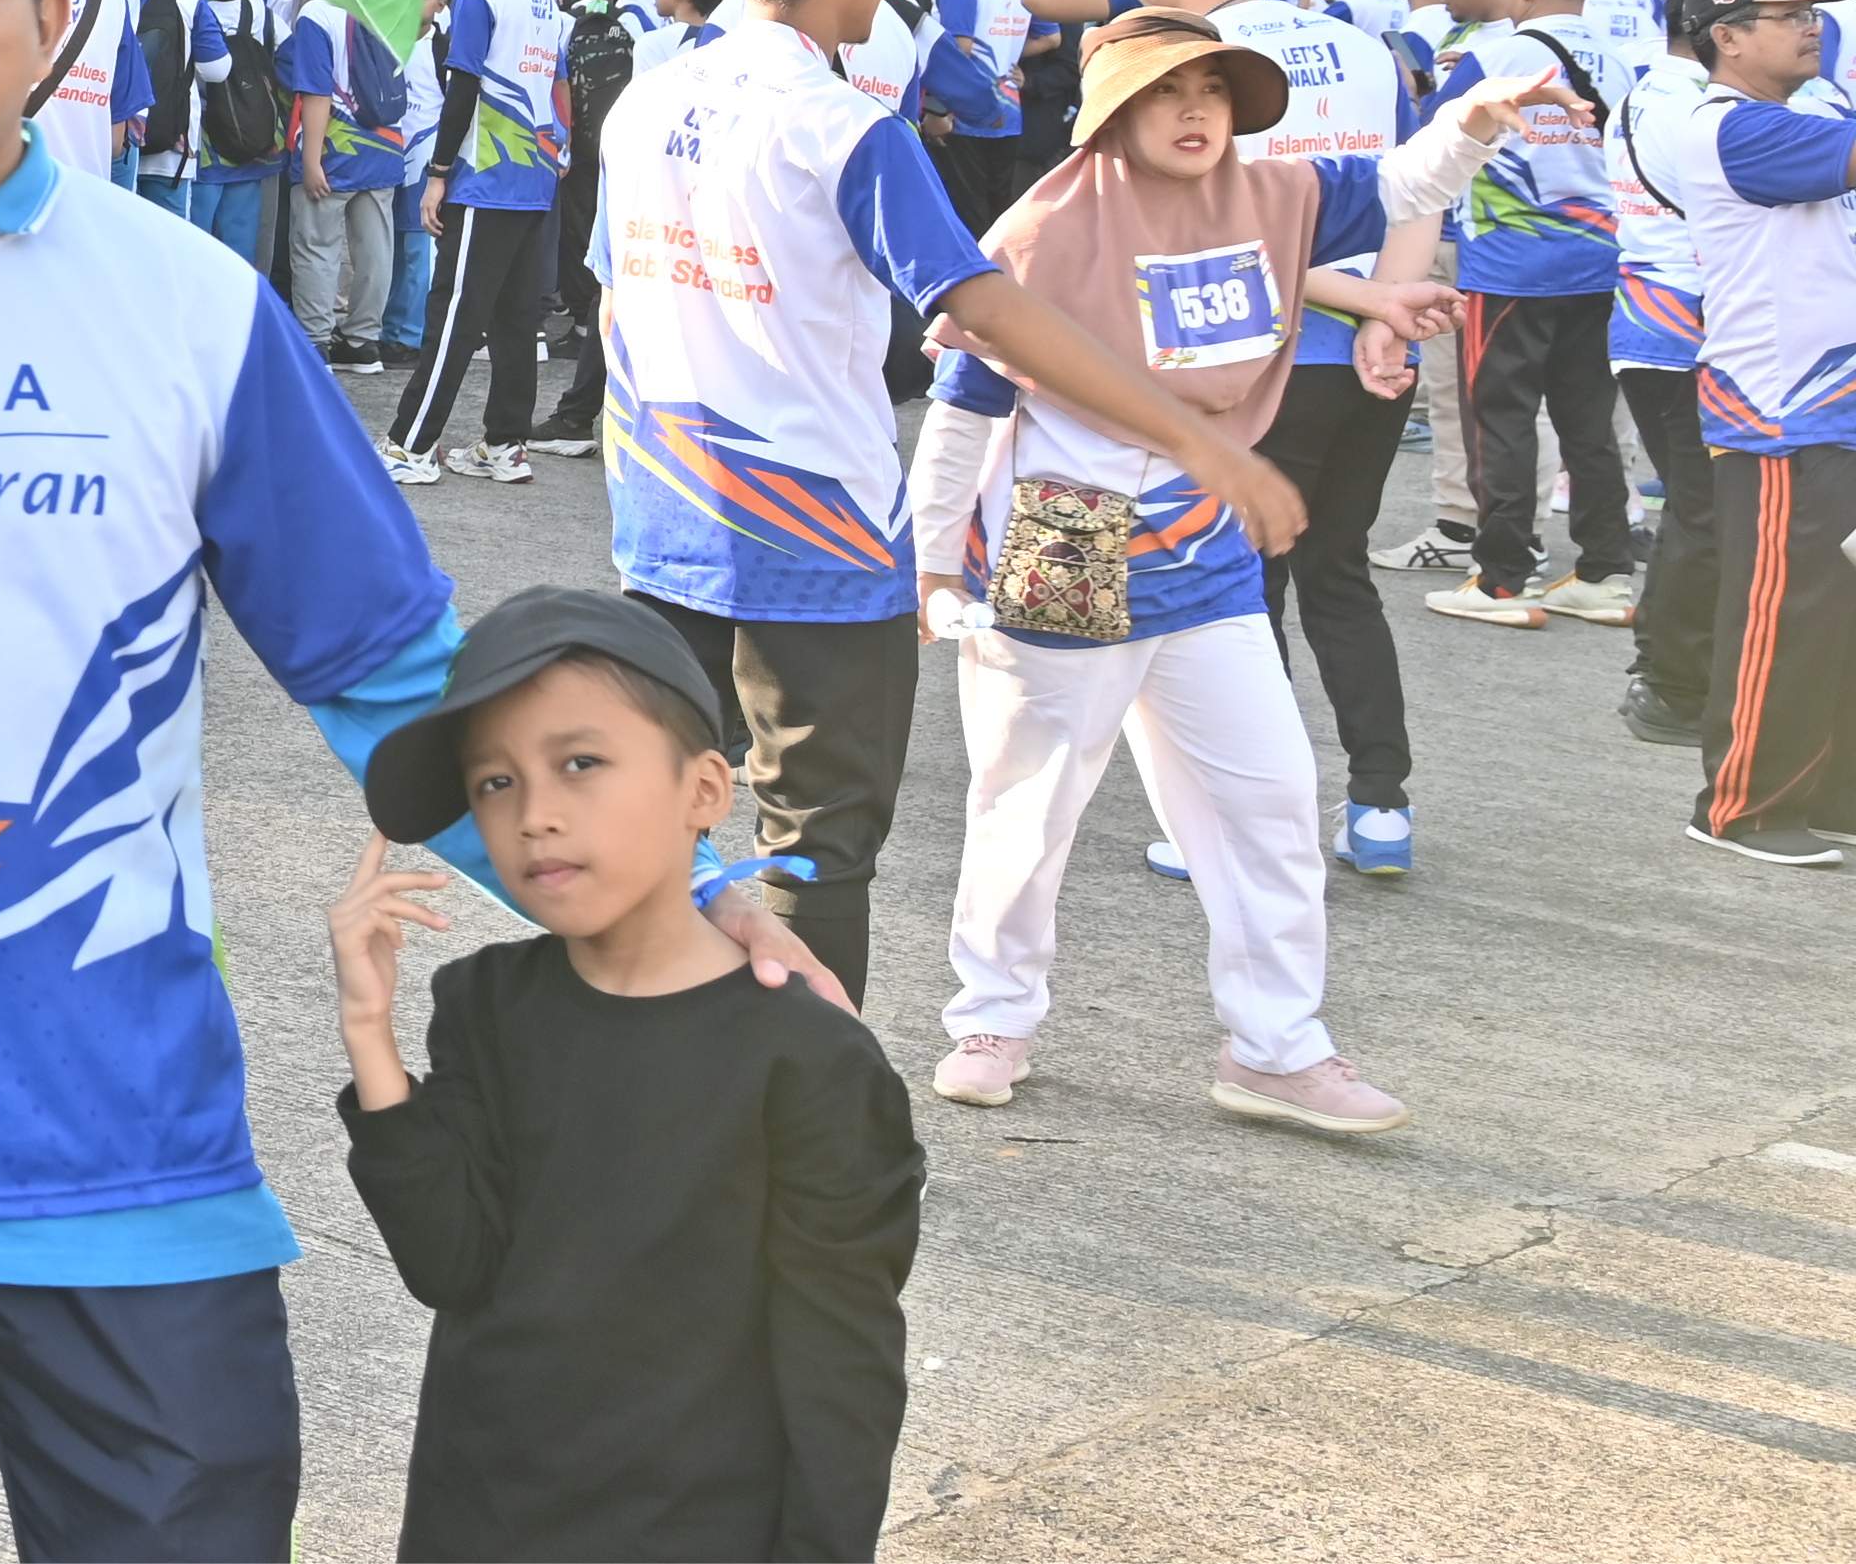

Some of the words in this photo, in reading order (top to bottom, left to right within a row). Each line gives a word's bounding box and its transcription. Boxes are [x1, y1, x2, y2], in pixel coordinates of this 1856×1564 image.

[1281, 43, 1325, 66] LET'S
[69, 61, 107, 84] alues
[52, 86, 110, 108] tandard
[851, 74, 900, 99] Values
[1267, 131, 1332, 157] Islamic
[670, 258, 775, 305] Standard
[1170, 278, 1251, 329] 1538
